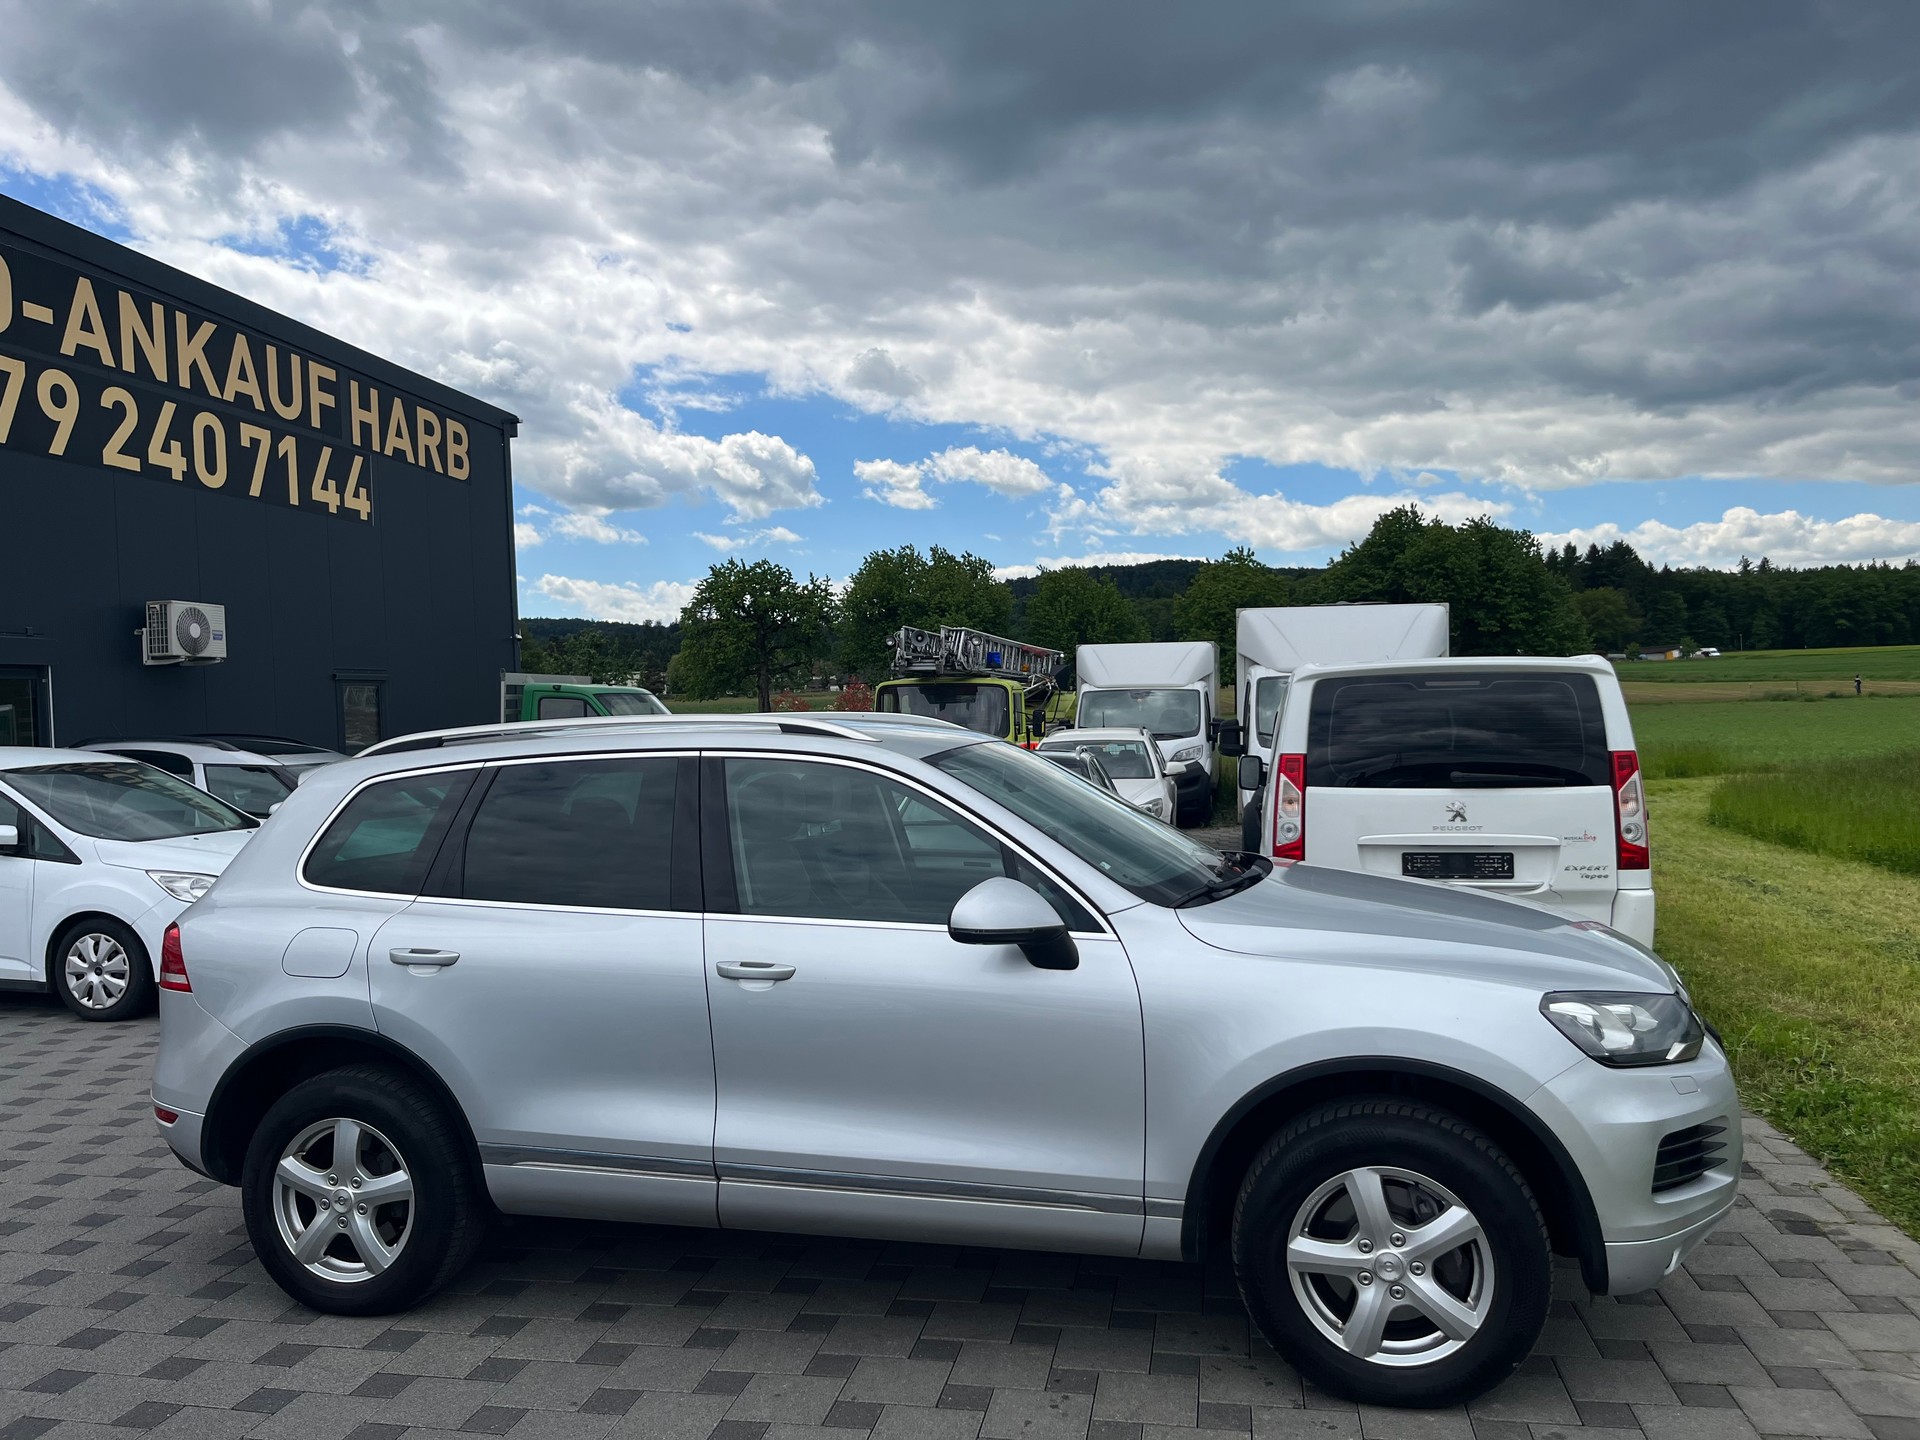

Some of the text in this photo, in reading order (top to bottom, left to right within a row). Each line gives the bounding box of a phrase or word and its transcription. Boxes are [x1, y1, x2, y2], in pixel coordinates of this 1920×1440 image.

[100, 385, 228, 489] 240
[350, 379, 470, 481] HARB
[1564, 864, 1609, 872] EXPERT
